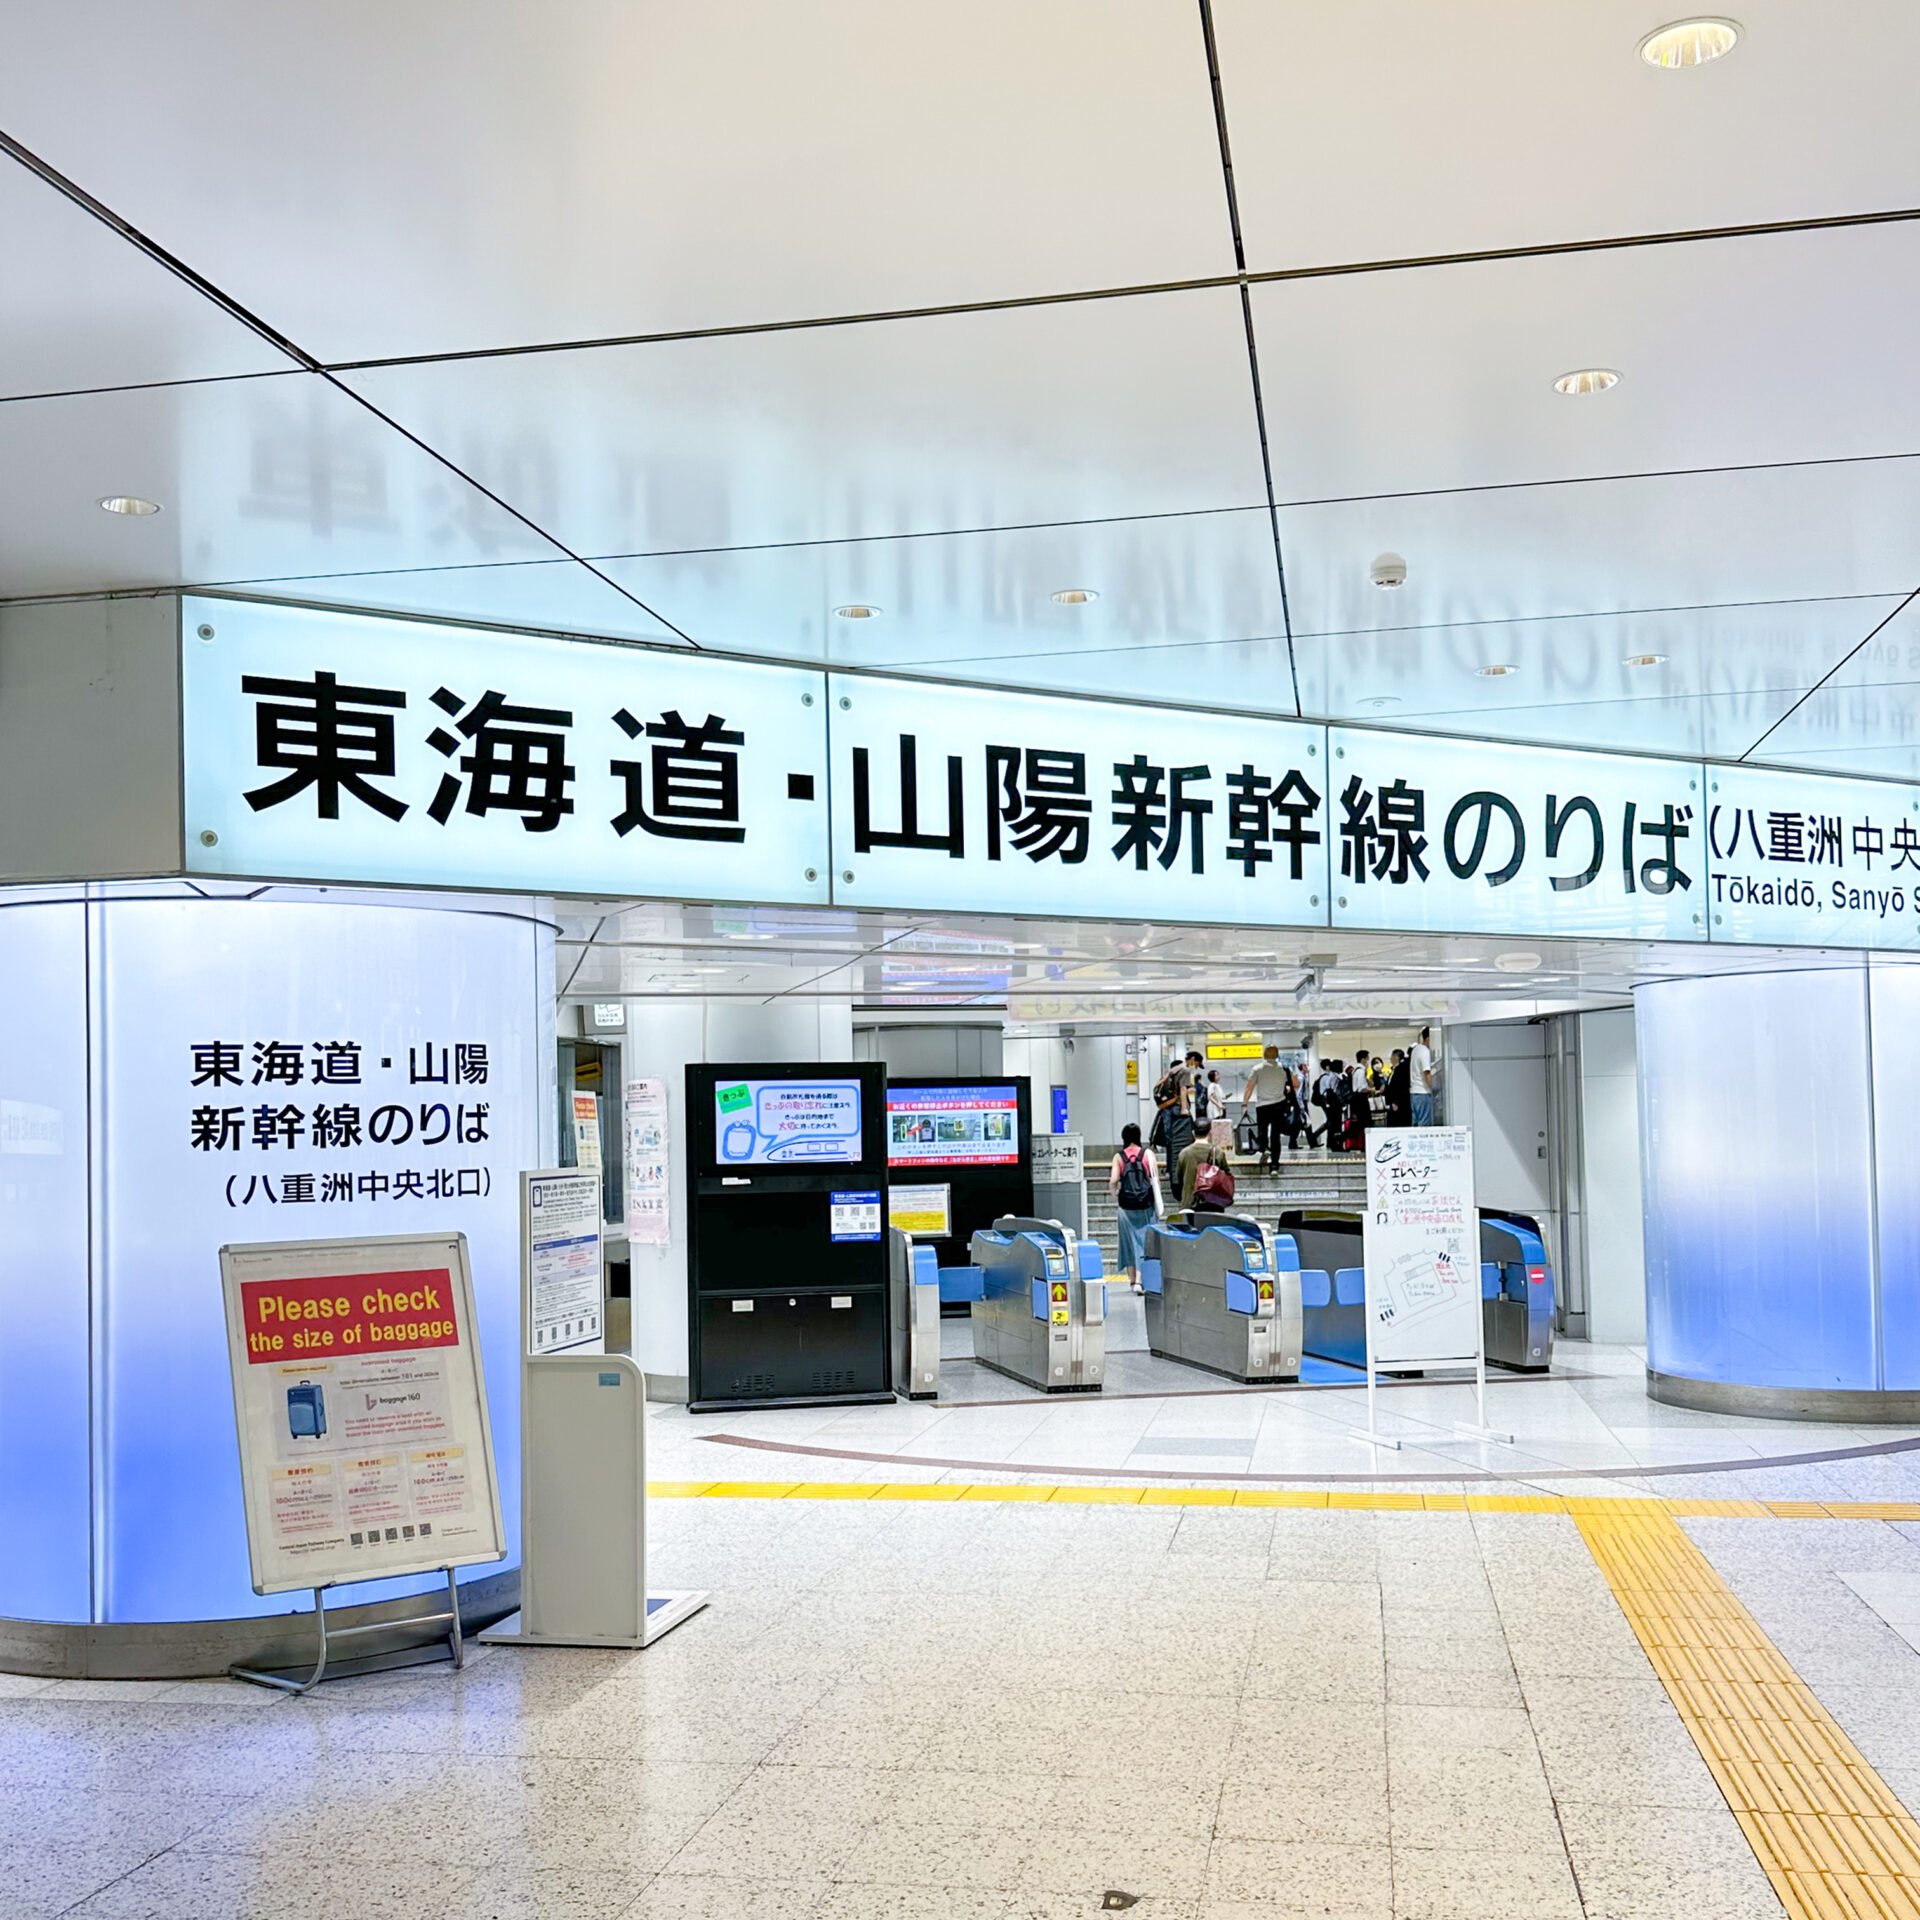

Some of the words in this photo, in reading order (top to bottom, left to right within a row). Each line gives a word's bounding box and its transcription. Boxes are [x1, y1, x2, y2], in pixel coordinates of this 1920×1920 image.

[241, 670, 1694, 896] 東海道・山陽新幹線のりば
[1711, 873, 1822, 914] Tōkaidō,
[1832, 880, 1905, 919] Sanyō
[190, 1040, 490, 1087] 東海道・山陽
[190, 1102, 491, 1152] 新幹線のりば
[1391, 1167, 1438, 1178] エレベーター
[1392, 1183, 1430, 1194] スロープ
[258, 1296, 351, 1324] Please
[362, 1285, 440, 1315] check
[250, 1332, 284, 1352] the
[292, 1328, 334, 1348] size
[342, 1324, 362, 1344] of
[370, 1320, 454, 1342] baggage
